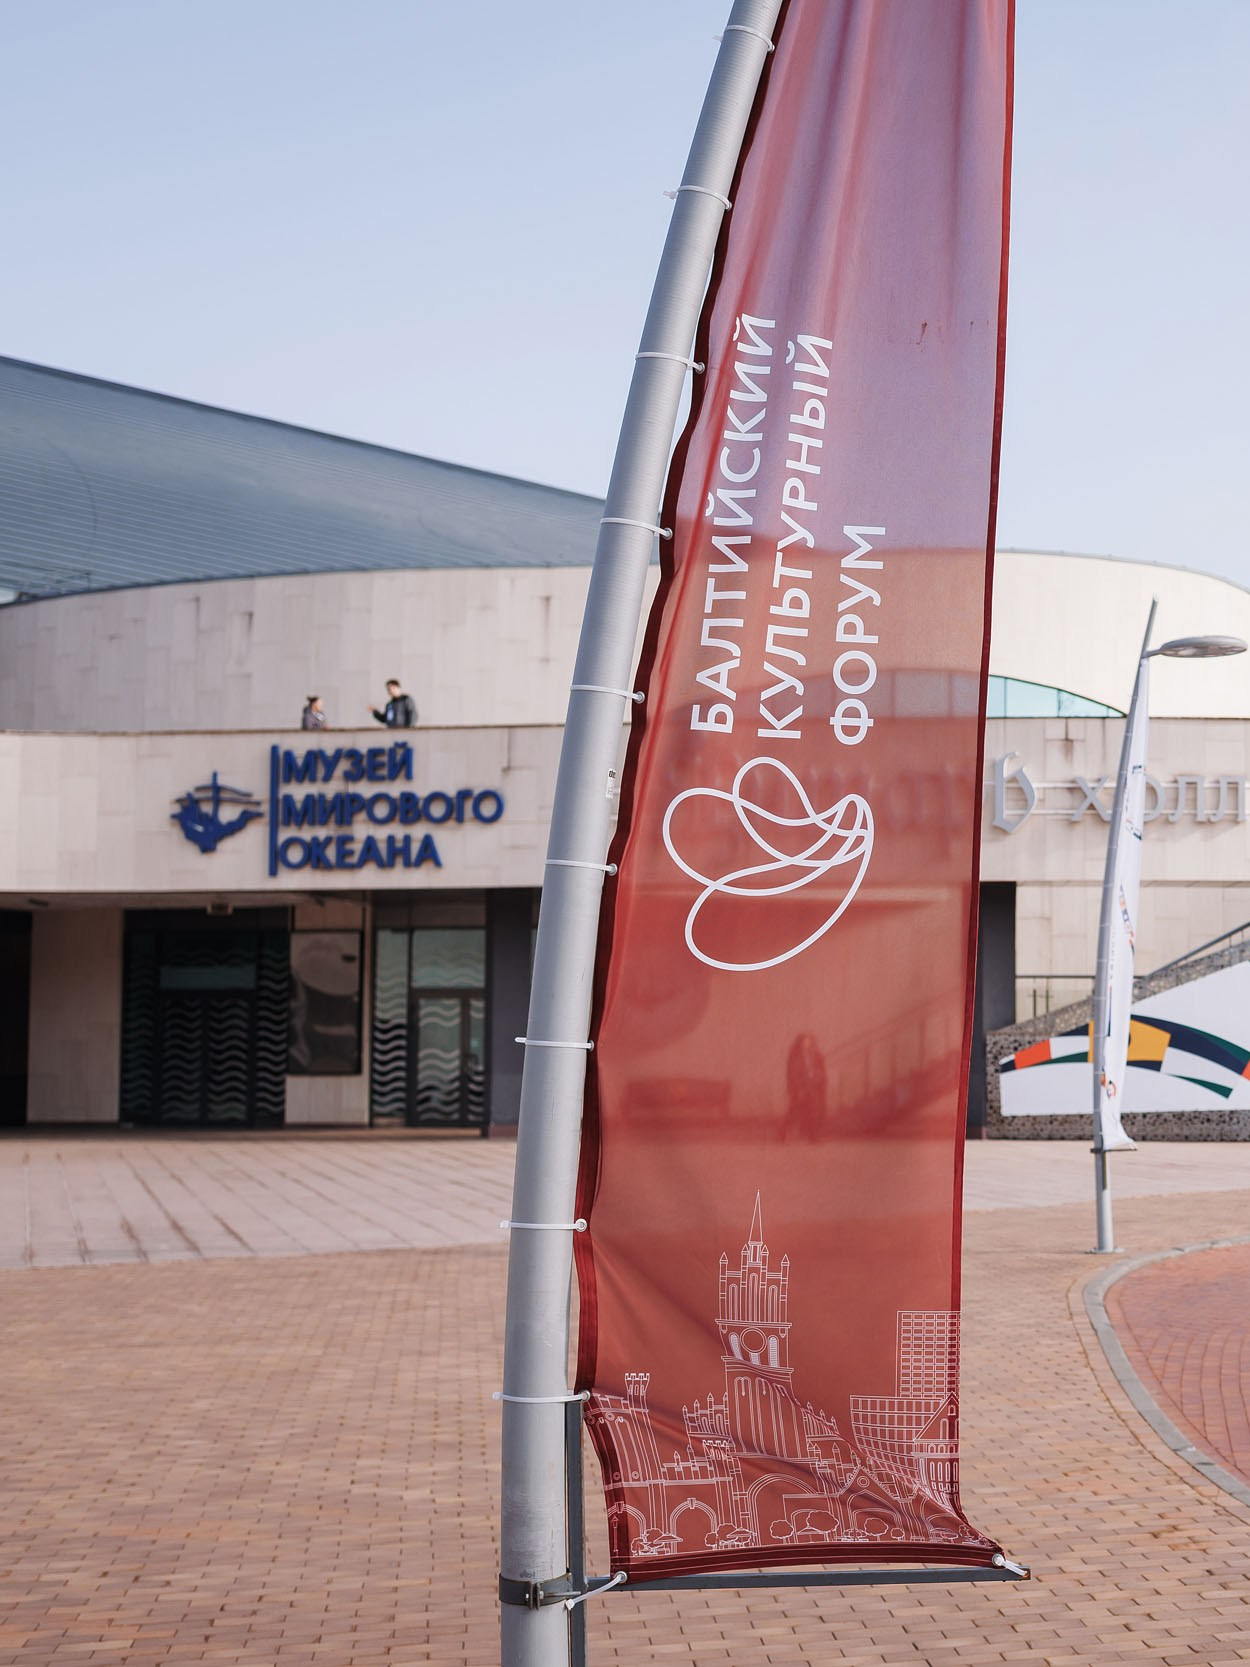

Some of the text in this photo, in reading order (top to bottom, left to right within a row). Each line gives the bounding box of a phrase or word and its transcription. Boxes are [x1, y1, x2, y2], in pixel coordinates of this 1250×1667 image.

[690, 313, 776, 734] БАЛТИЙСКИЙ
[757, 334, 833, 738] КУЛЬТУРНЫЙ
[829, 524, 886, 746] ФОРУМ
[282, 741, 414, 783] МУЗЕЙ
[282, 789, 504, 826] МИРОВОГО
[279, 834, 442, 870] ОКЕАНА
